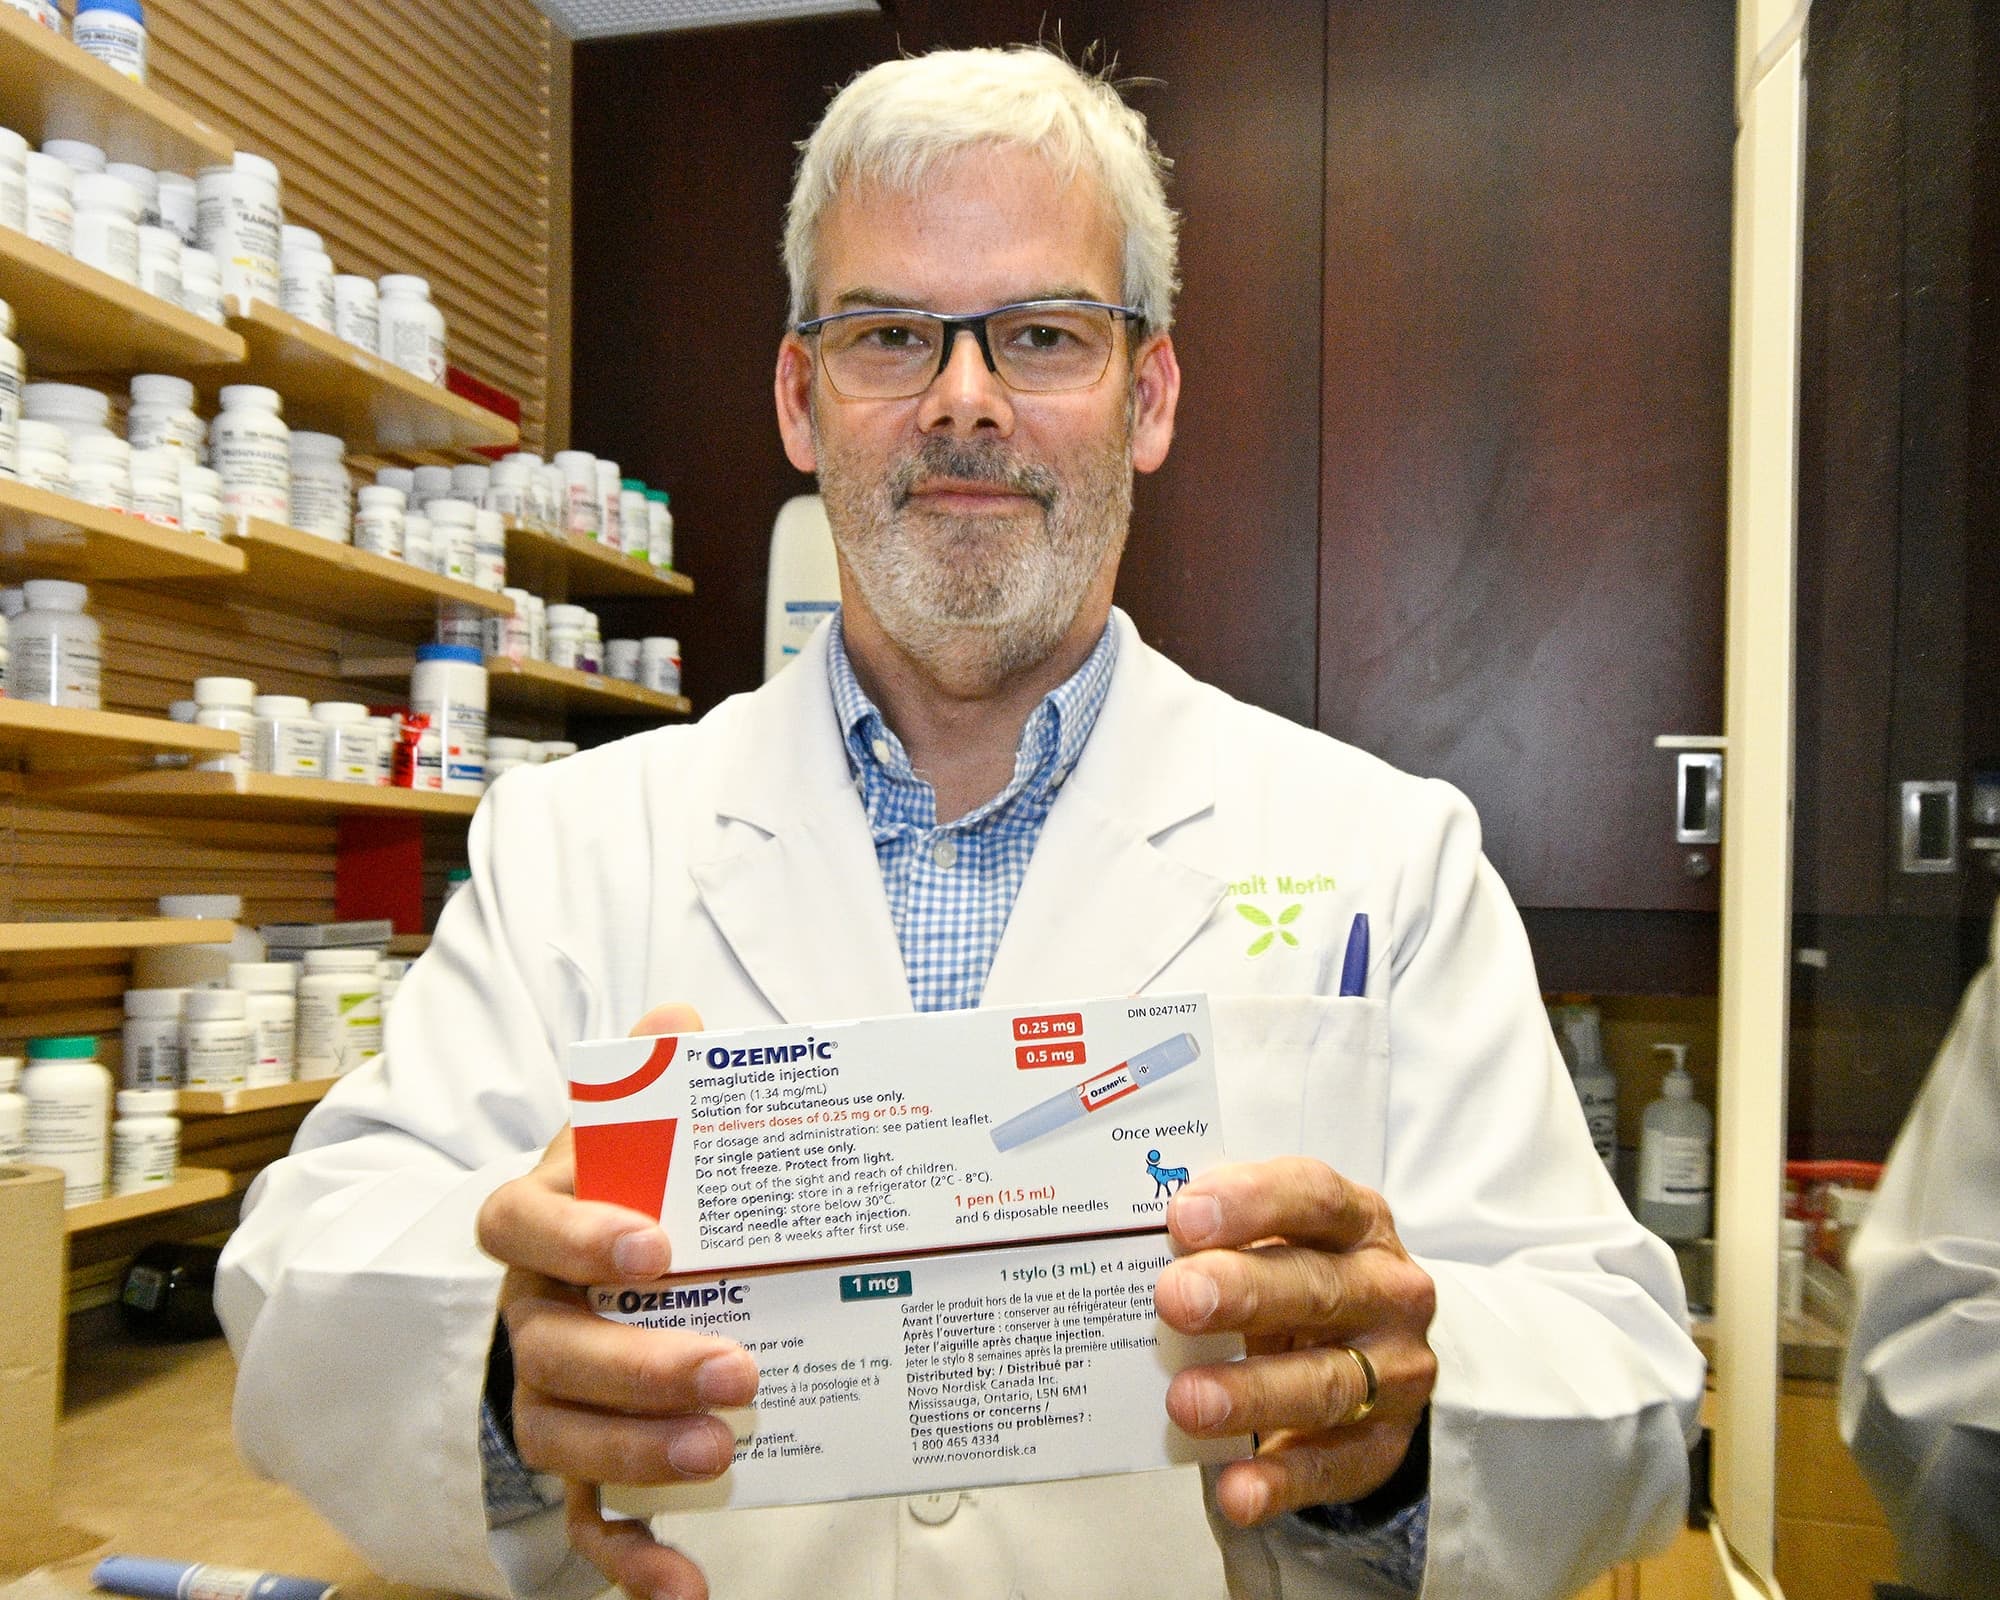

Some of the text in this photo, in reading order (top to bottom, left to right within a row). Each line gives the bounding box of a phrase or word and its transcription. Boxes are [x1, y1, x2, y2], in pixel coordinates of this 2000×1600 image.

[1127, 1003, 1197, 1018] DIN 02471477
[1019, 1021, 1076, 1035] 0.25 mg
[687, 1049, 702, 1062] Pr
[1025, 1050, 1074, 1063] 0.5 mg
[688, 1065, 839, 1089] semaglutide injection
[690, 1083, 827, 1107] 2 mg/pen (1.34 mg/mL)
[690, 1090, 904, 1119] Solution for subcutaneous use only.
[692, 1104, 932, 1134] Pen delivers doses 0.25 mg 0.5 mg.
[1111, 1120, 1208, 1141] Once weekly
[693, 1113, 992, 1150] For dosage and administration: see patient leaflet.
[694, 1141, 856, 1165] For single patient use only.
[695, 1151, 894, 1179] Do not freeze. Protect from light.
[696, 1163, 957, 1196] Keep out the sight and reach children.
[697, 1171, 992, 1208] Before opening: store refrigerator (2°C 8°C).
[698, 1194, 895, 1222] After opening: store below 30°C.
[954, 1185, 1055, 1209] 1 pen (1.5 mL)
[699, 1207, 910, 1236] Discard needle after each injection.
[955, 1199, 1108, 1224] and 6 disposable needles
[700, 1222, 908, 1250] Discard pen weeks after first use.
[999, 1254, 1173, 1282] 1 stylo (3 mL) aiguille
[852, 1276, 898, 1292] 1 mg
[900, 1284, 1125, 1314] Garder produit hors portée
[690, 1310, 750, 1328] injection
[902, 1315, 933, 1327] Avant
[1003, 1307, 1048, 1318] conserver
[1067, 1298, 1127, 1313] réfrigérateur
[903, 1328, 933, 1343] Après
[1004, 1320, 1049, 1332] conserver
[1083, 1311, 1142, 1326] température
[760, 1336, 804, 1353] par voie
[903, 1343, 929, 1355] Jeter
[982, 1335, 1011, 1351] après
[1014, 1334, 1052, 1347] chaque
[1055, 1328, 1104, 1343] injection.
[905, 1336, 1160, 1368] Jeter stylo semaines après première utilisation.
[759, 1358, 892, 1378] ecter doses mg.
[906, 1359, 1083, 1383] Distributed by: Distribué par
[811, 1377, 858, 1394] posologie
[907, 1374, 1058, 1396] Novo Nordisk Canada Inc.
[908, 1384, 1087, 1410] Mississauga, Ontario, L5N 6M1
[760, 1391, 861, 1409] destiné patients.
[909, 1405, 1041, 1425] Questions concerns
[910, 1412, 1084, 1438] Des questions problèmes?
[755, 1432, 797, 1448] patient.
[780, 1444, 823, 1457] lumière.
[911, 1433, 999, 1451] 1 800 465 4334
[912, 1445, 1036, 1464] www.novonordisk.ca
